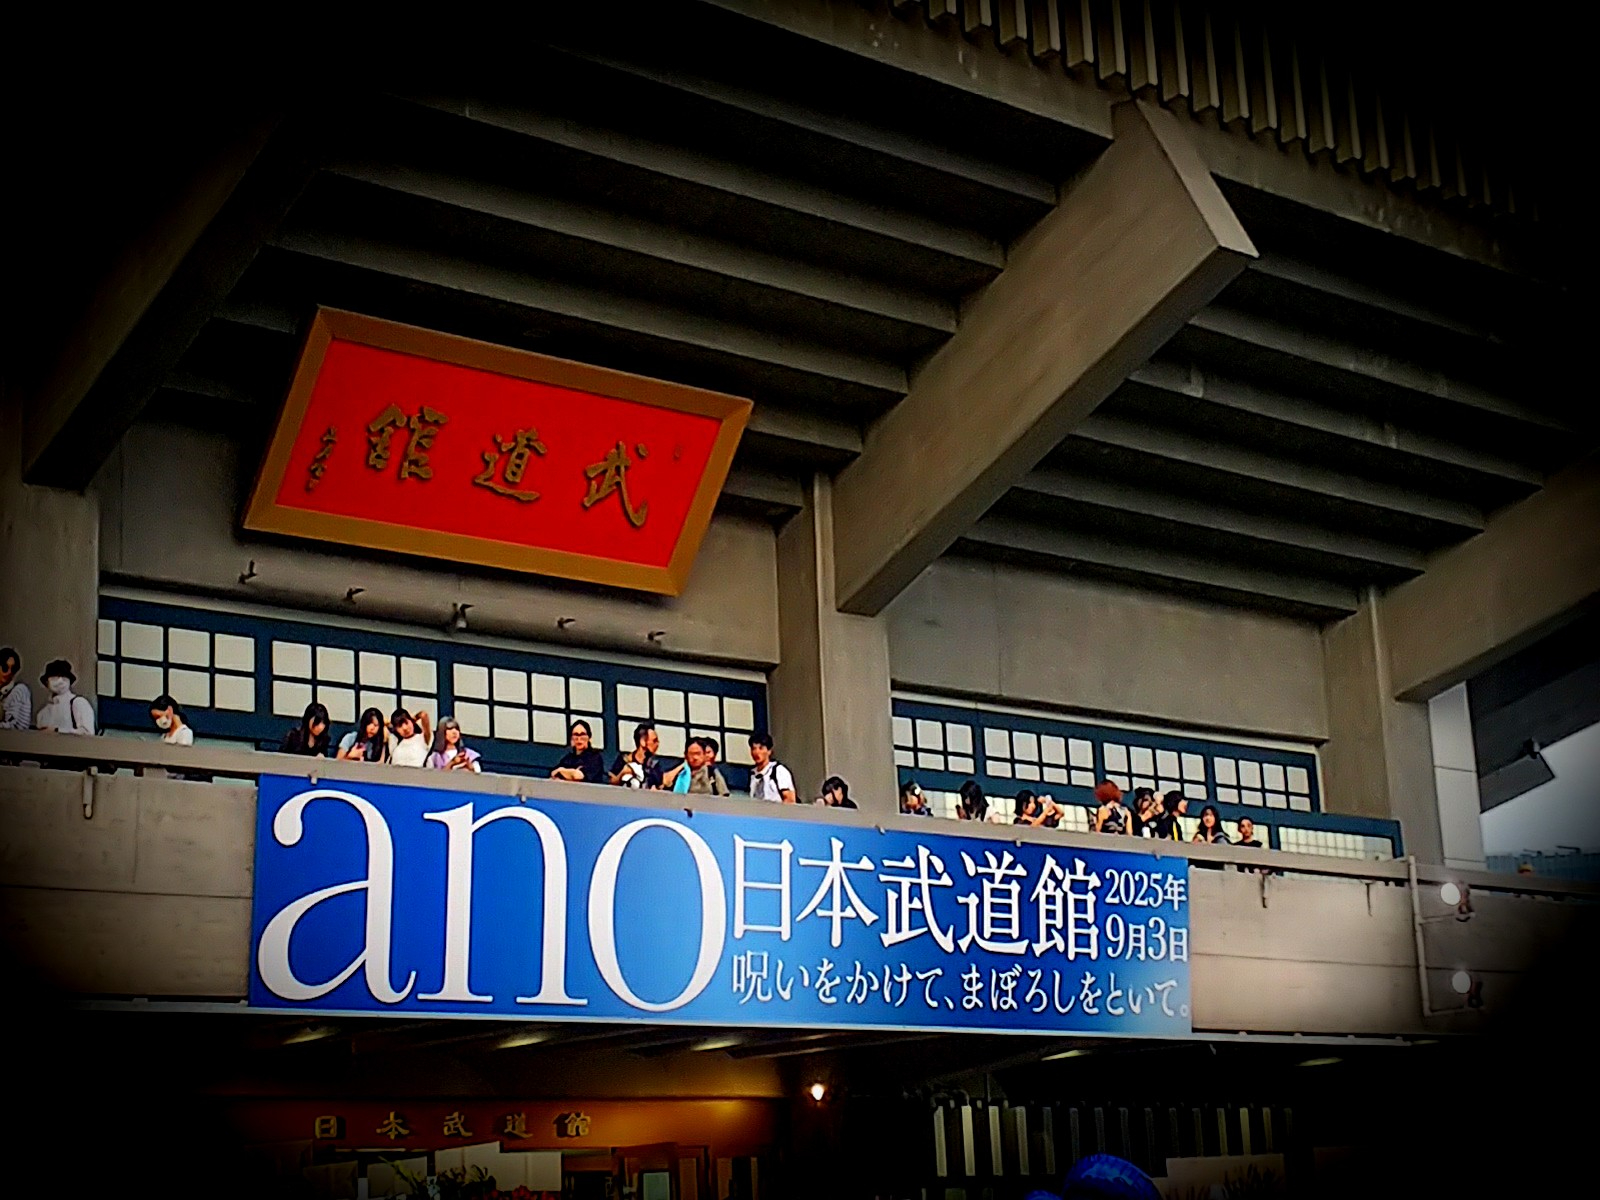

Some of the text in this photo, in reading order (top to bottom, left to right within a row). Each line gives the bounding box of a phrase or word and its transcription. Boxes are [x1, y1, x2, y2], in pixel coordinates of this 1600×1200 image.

[258, 789, 727, 1012] ano
[732, 834, 1101, 961] 日本武道館
[1104, 868, 1187, 911] 2025年
[1104, 913, 1188, 962] 9月3日
[732, 949, 1189, 1018] 呪いをかけて、まぼろしをといて。
[314, 1111, 592, 1140] 日本武道館
